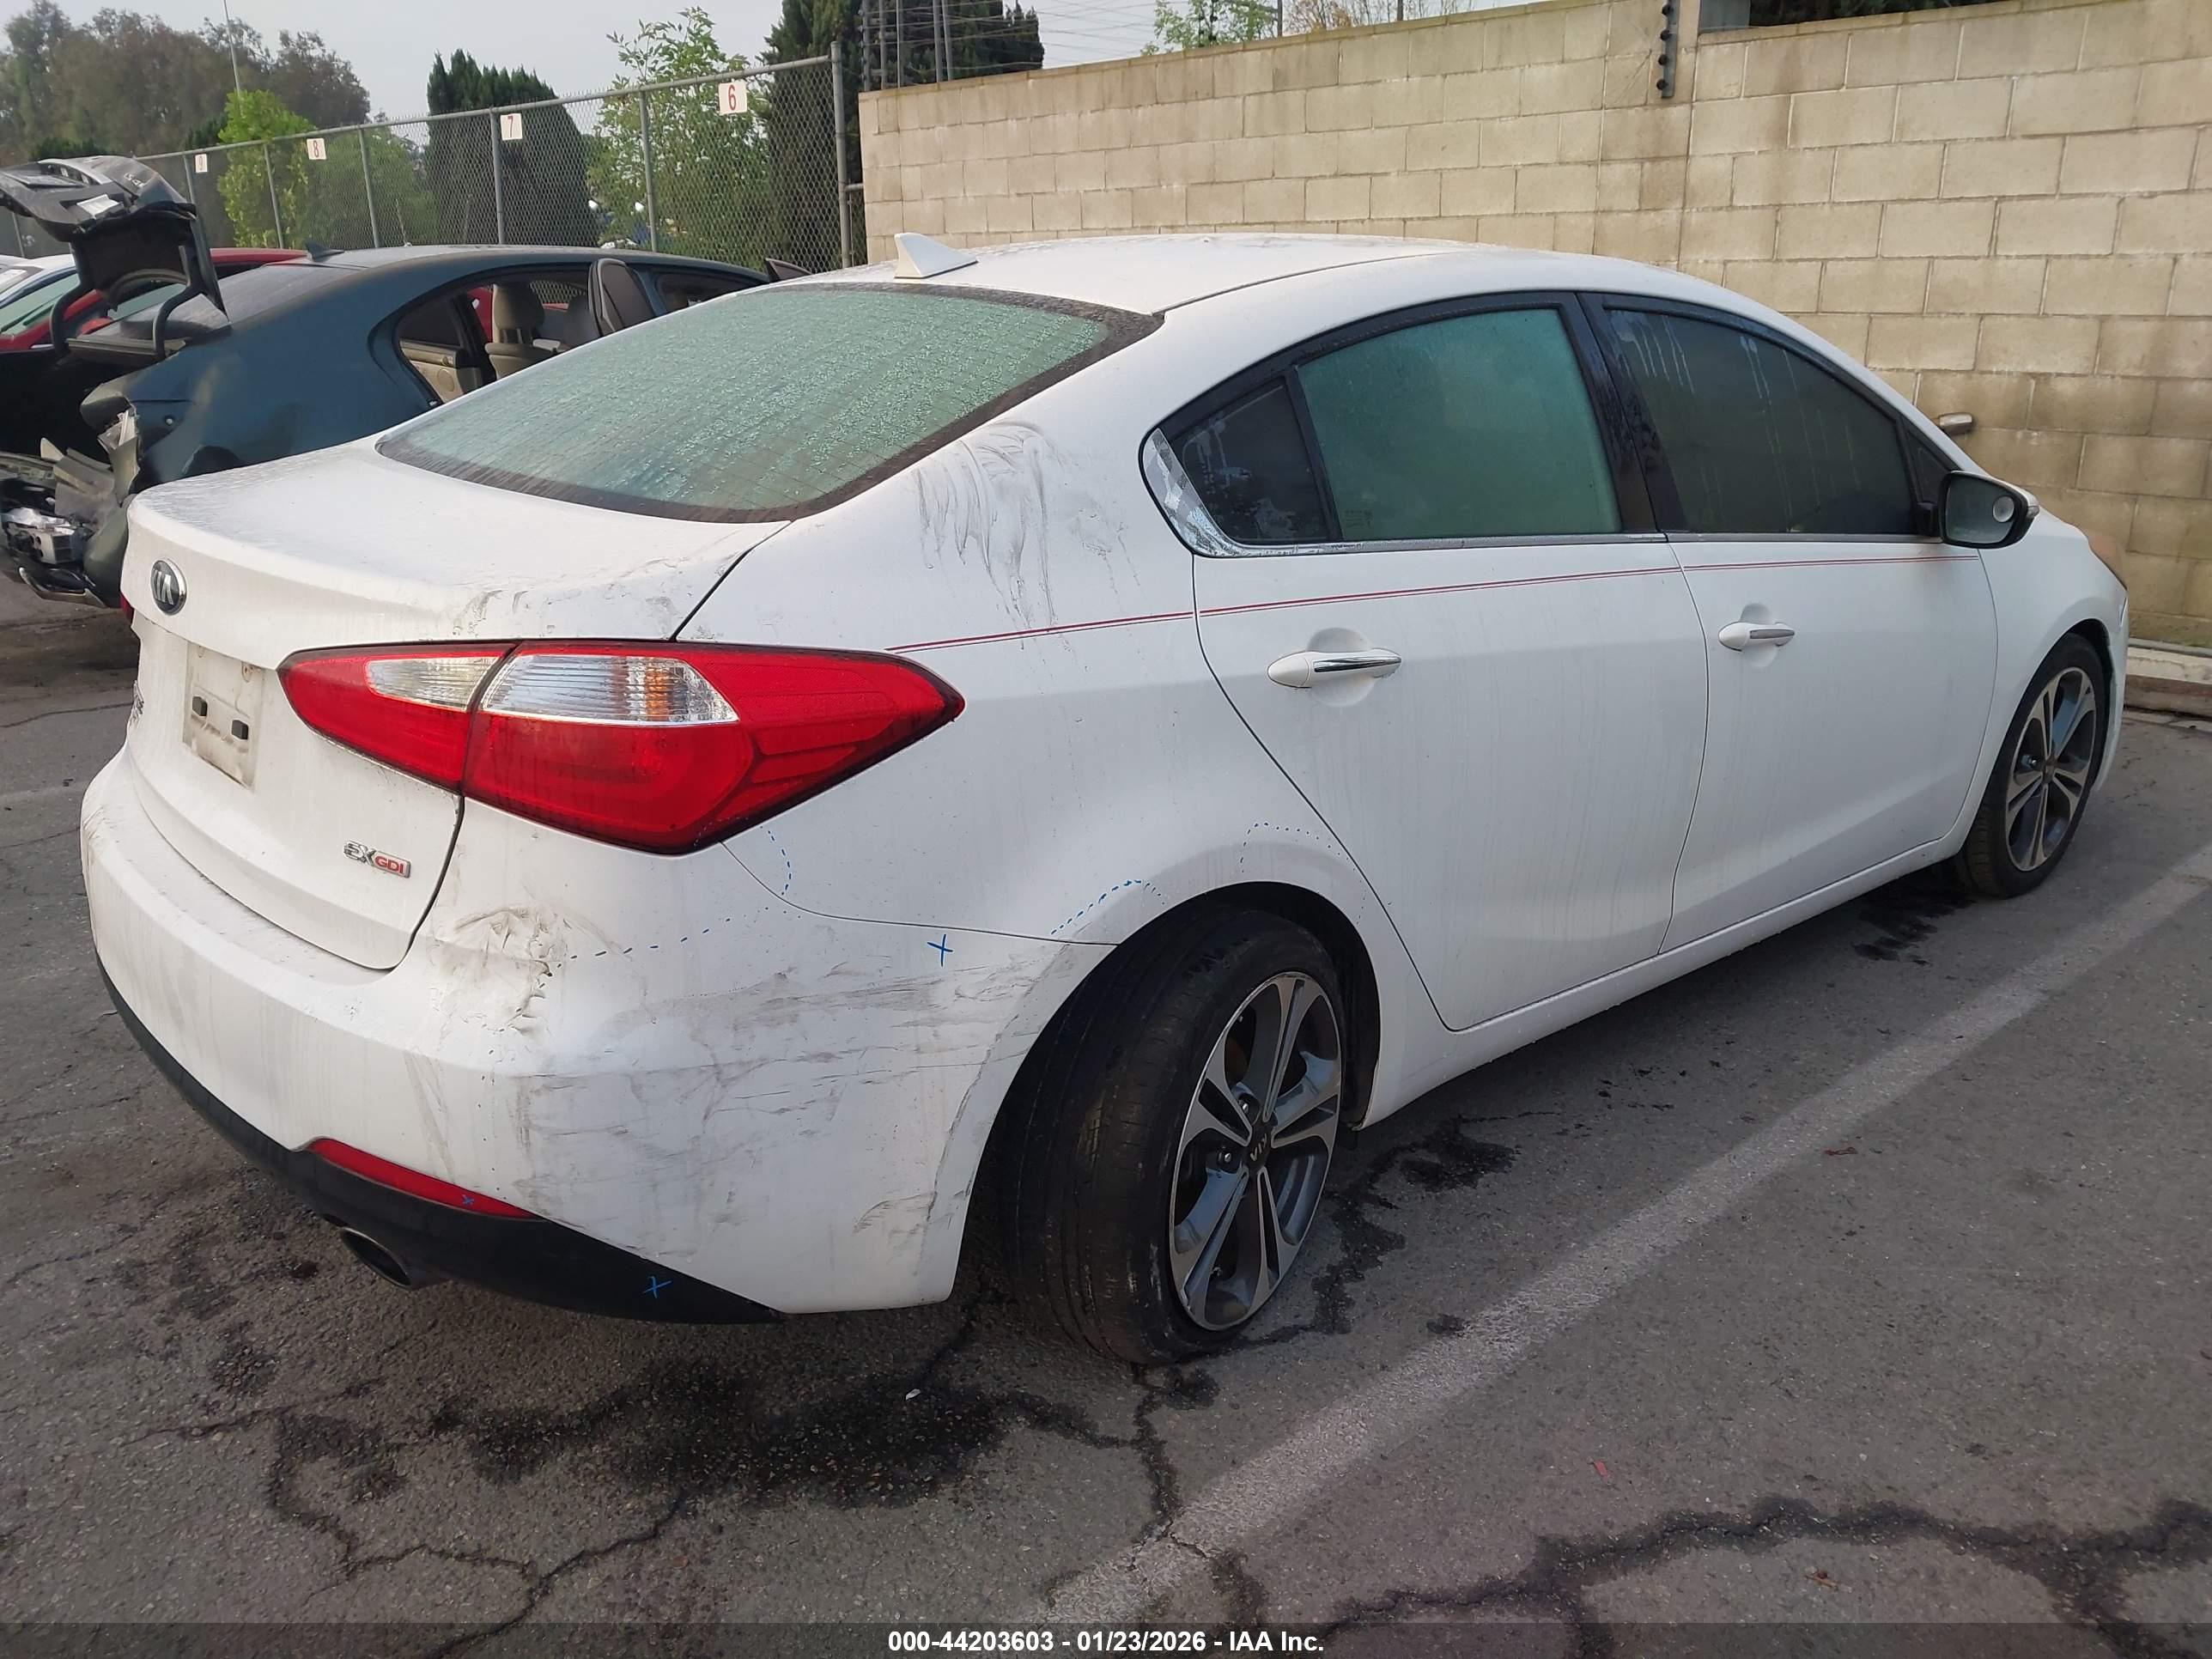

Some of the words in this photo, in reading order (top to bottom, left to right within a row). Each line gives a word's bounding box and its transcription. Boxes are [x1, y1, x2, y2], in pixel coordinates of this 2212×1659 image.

[728, 84, 736, 111] 6
[507, 115, 514, 138] 7
[313, 140, 319, 157] 8
